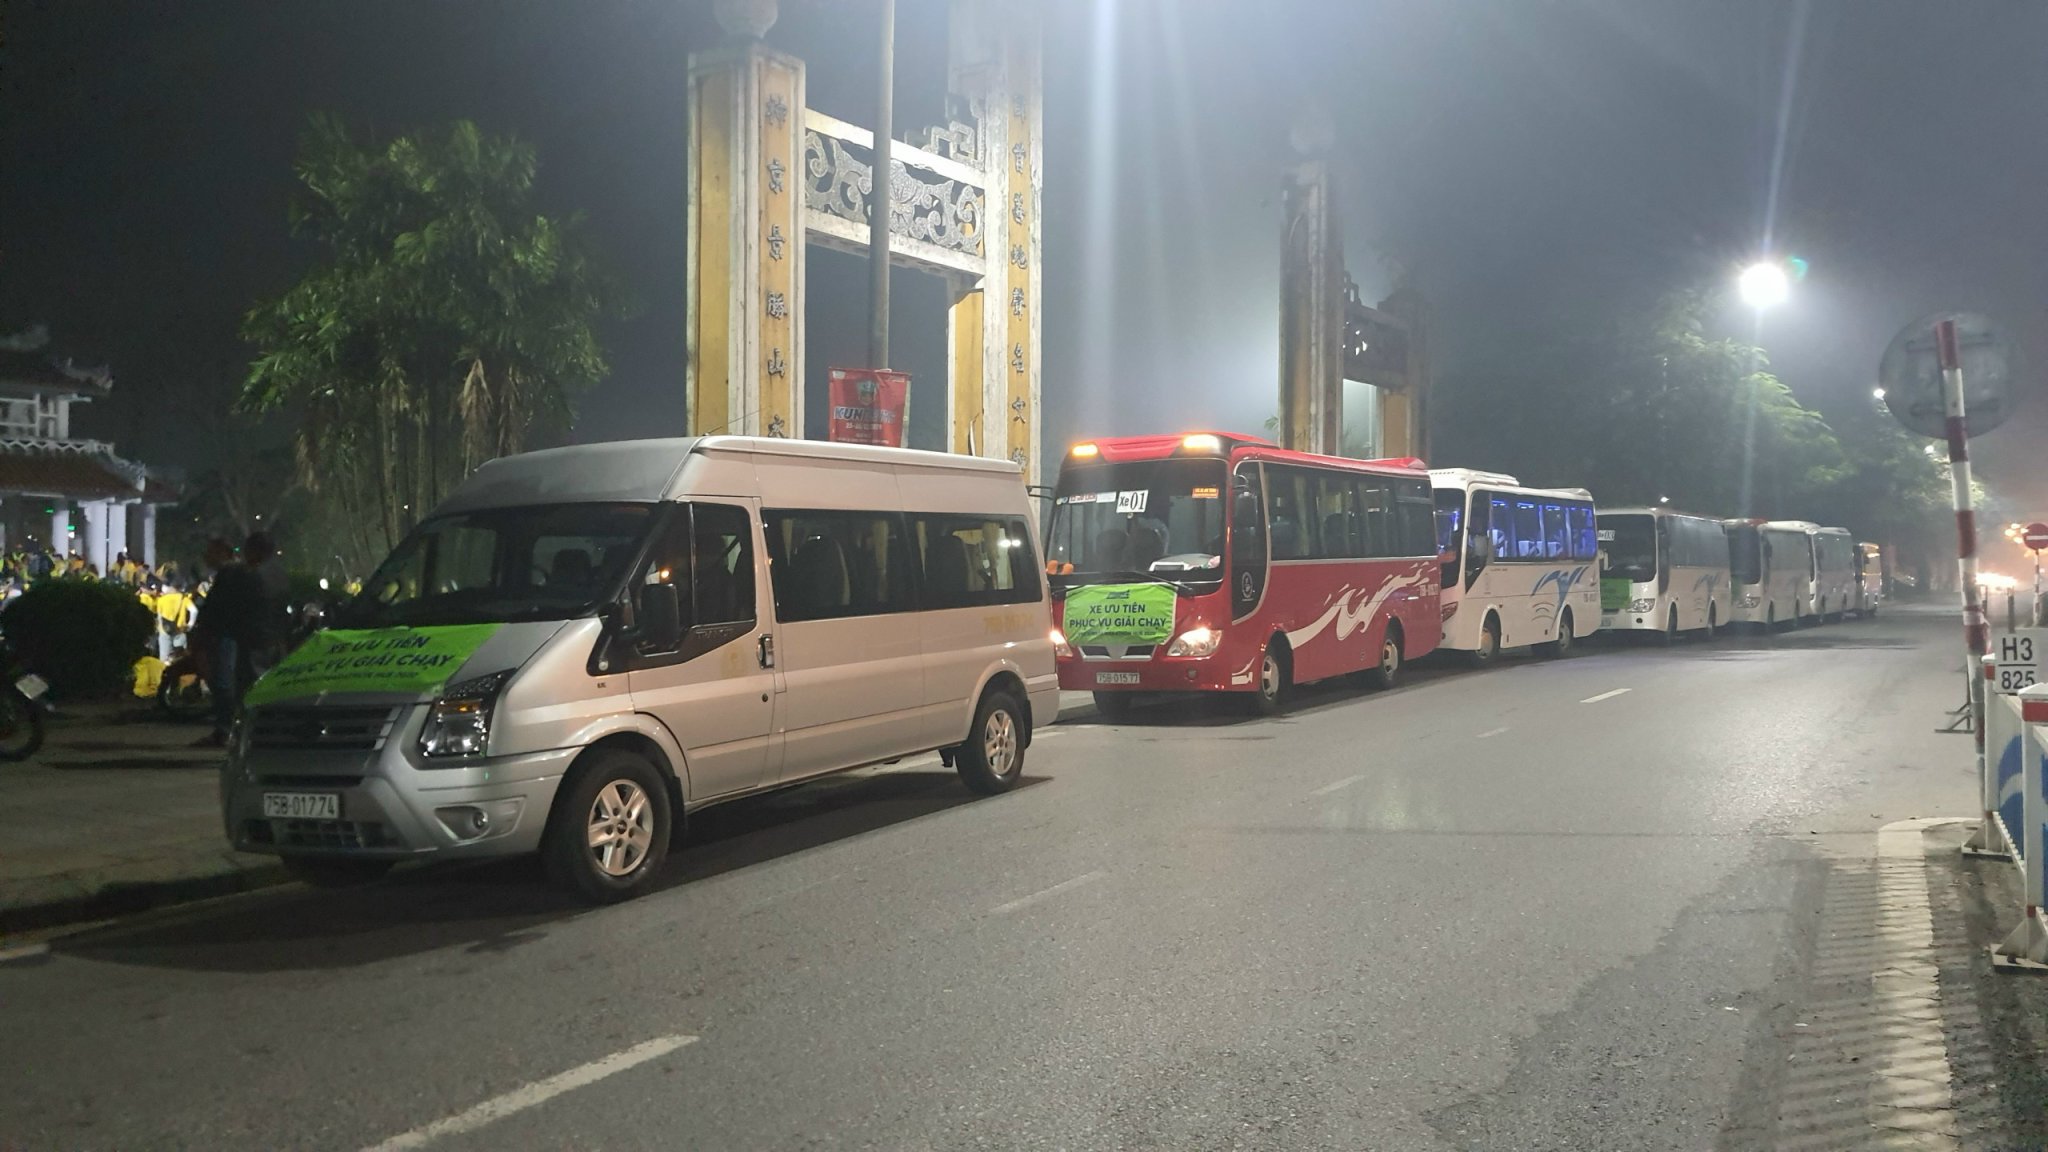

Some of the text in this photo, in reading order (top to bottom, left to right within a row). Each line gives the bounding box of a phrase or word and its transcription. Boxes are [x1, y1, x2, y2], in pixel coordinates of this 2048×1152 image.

[1119, 496, 1129, 507] Xe
[1130, 492, 1146, 510] 01
[1089, 602, 1146, 614] XE ƯU TIÊN
[1069, 618, 1096, 630] PHỤC
[1098, 618, 1112, 630] VỤ
[1138, 618, 1167, 630] CHẠY
[2002, 637, 2033, 661] H3
[399, 654, 455, 671] CHẠY
[2001, 670, 2035, 690] 825
